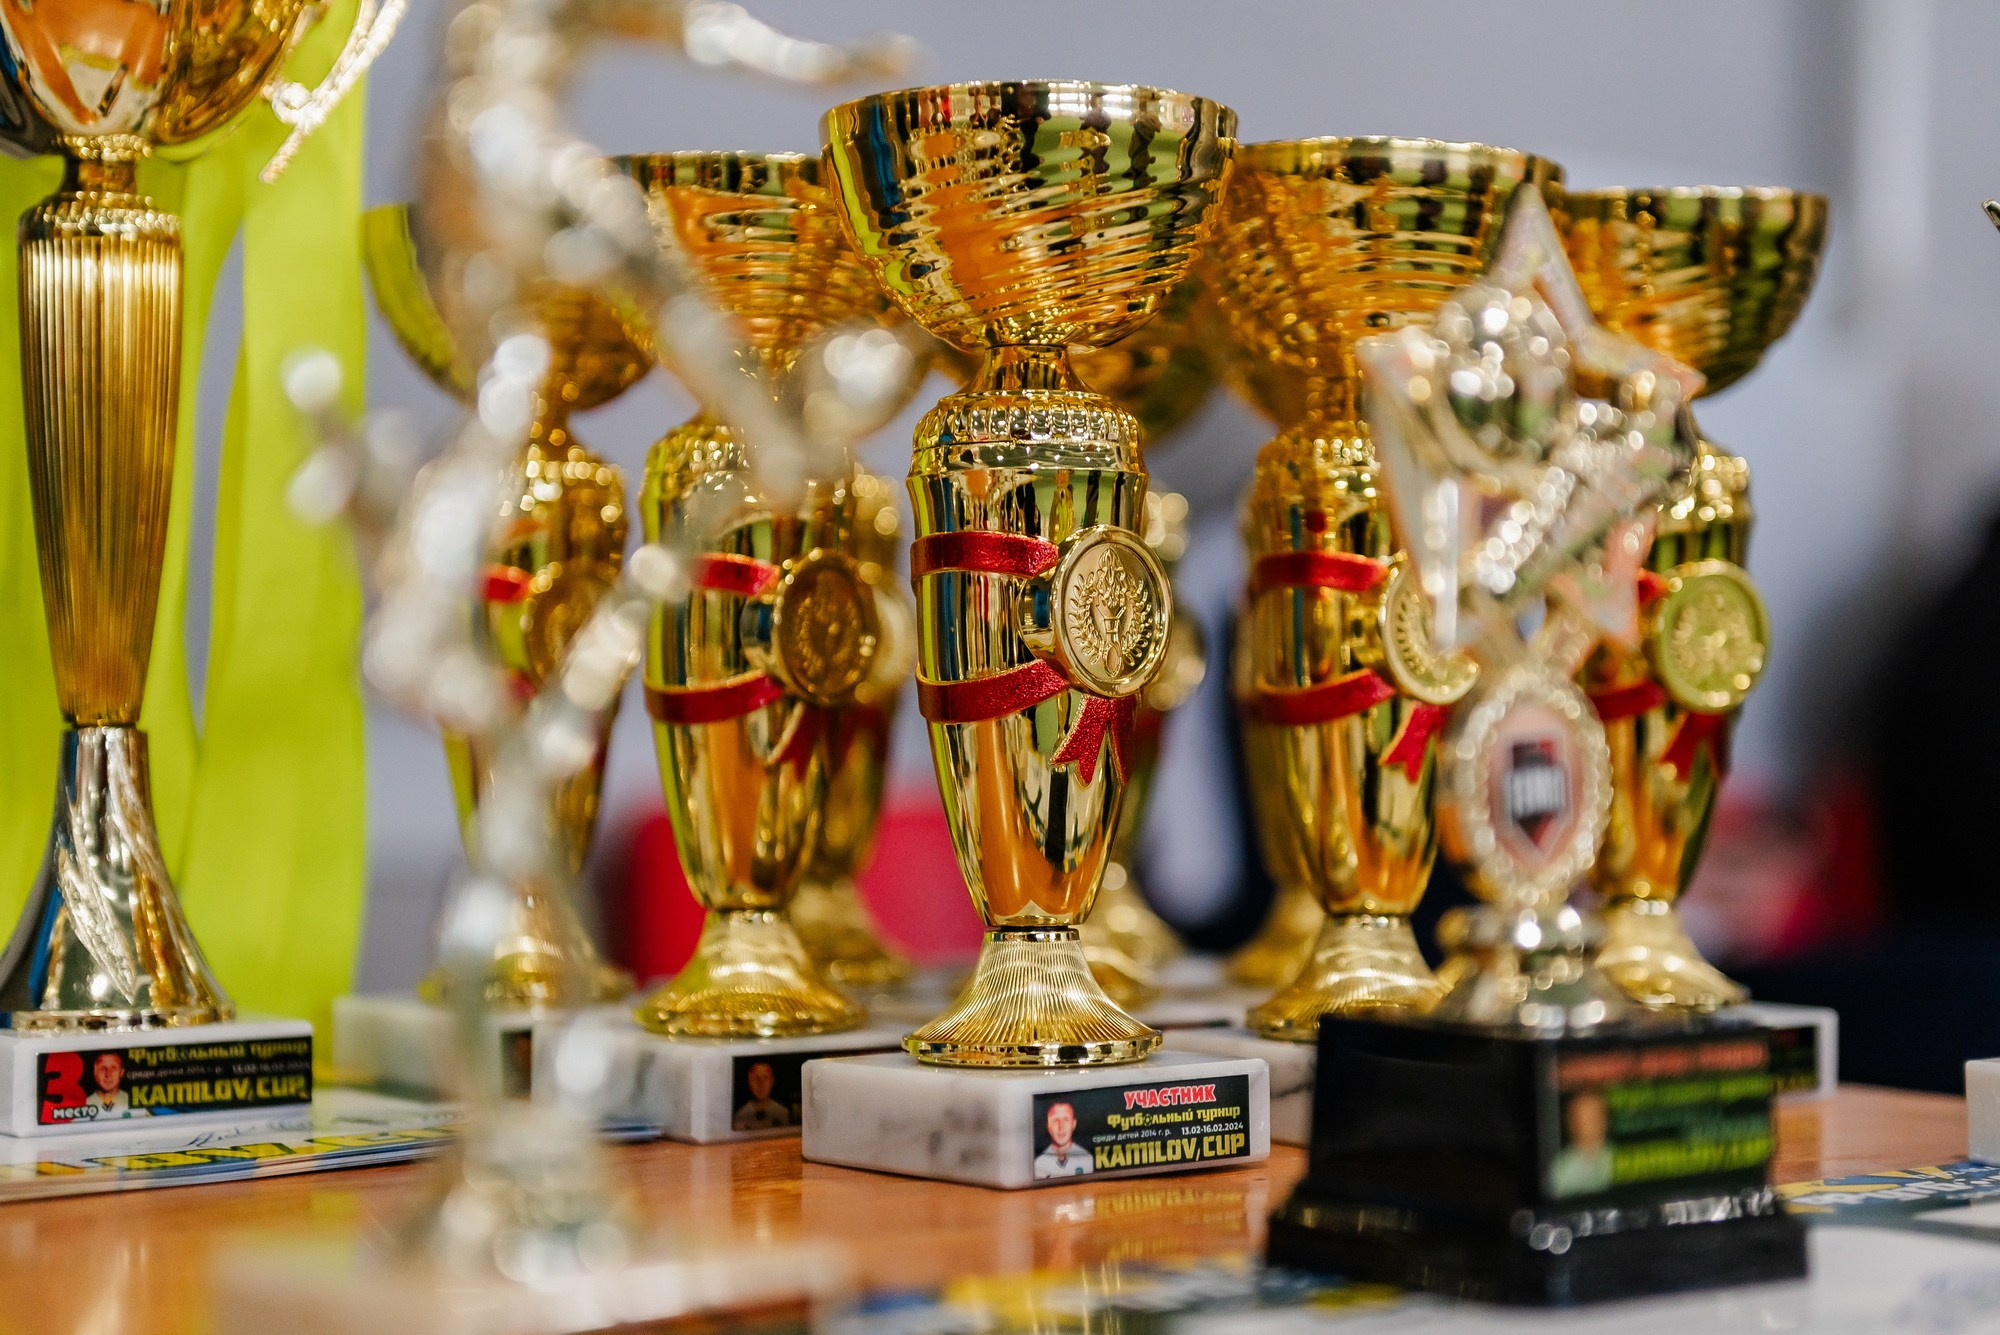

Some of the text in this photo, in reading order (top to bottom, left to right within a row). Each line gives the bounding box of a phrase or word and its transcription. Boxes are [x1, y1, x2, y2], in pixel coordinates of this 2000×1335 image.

[41, 1051, 88, 1123] 3
[1123, 1084, 1217, 1110] УЧАСТНИК
[1196, 1106, 1241, 1122] турнир
[1141, 1129, 1157, 1138] 2014
[1181, 1122, 1244, 1136] 13.02-16.02.2024
[1203, 1133, 1245, 1158] CUP
